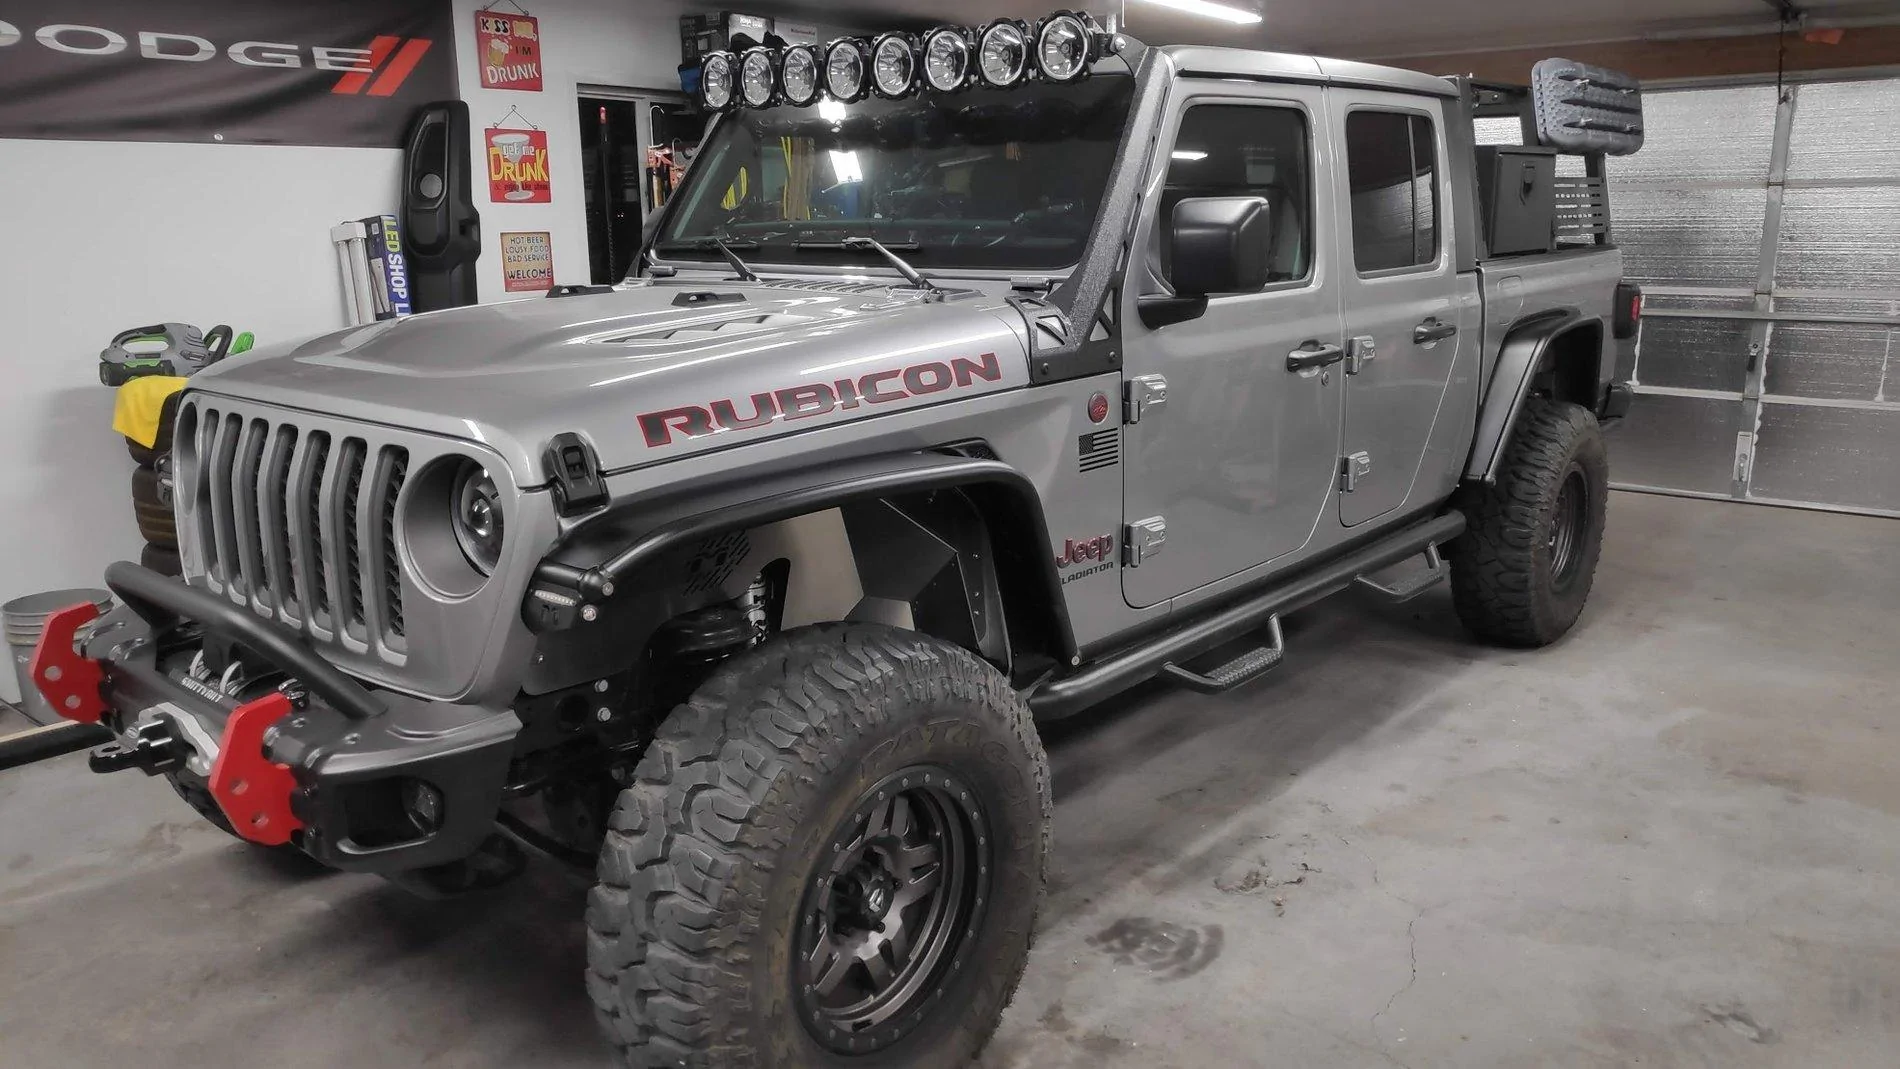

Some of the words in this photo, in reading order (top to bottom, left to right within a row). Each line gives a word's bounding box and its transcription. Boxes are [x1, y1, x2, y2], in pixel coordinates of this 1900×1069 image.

[0, 20, 374, 74] ODGE
[487, 63, 540, 84] DRUNK
[503, 143, 519, 156] get
[523, 146, 535, 155] me
[490, 147, 549, 181] DRUNK
[383, 220, 401, 253] LED
[510, 236, 525, 245] HOT
[526, 236, 544, 244] BEER
[505, 246, 528, 255] LOUSY
[530, 245, 550, 253] FOOD
[507, 255, 523, 263] BAD
[524, 254, 550, 262] SERVICE
[388, 253, 408, 299] SHOP
[507, 268, 552, 280] WELCOME
[636, 352, 1002, 448] RUBICON
[1056, 533, 1114, 569] Jeep
[1061, 561, 1114, 585] LADIATOR
